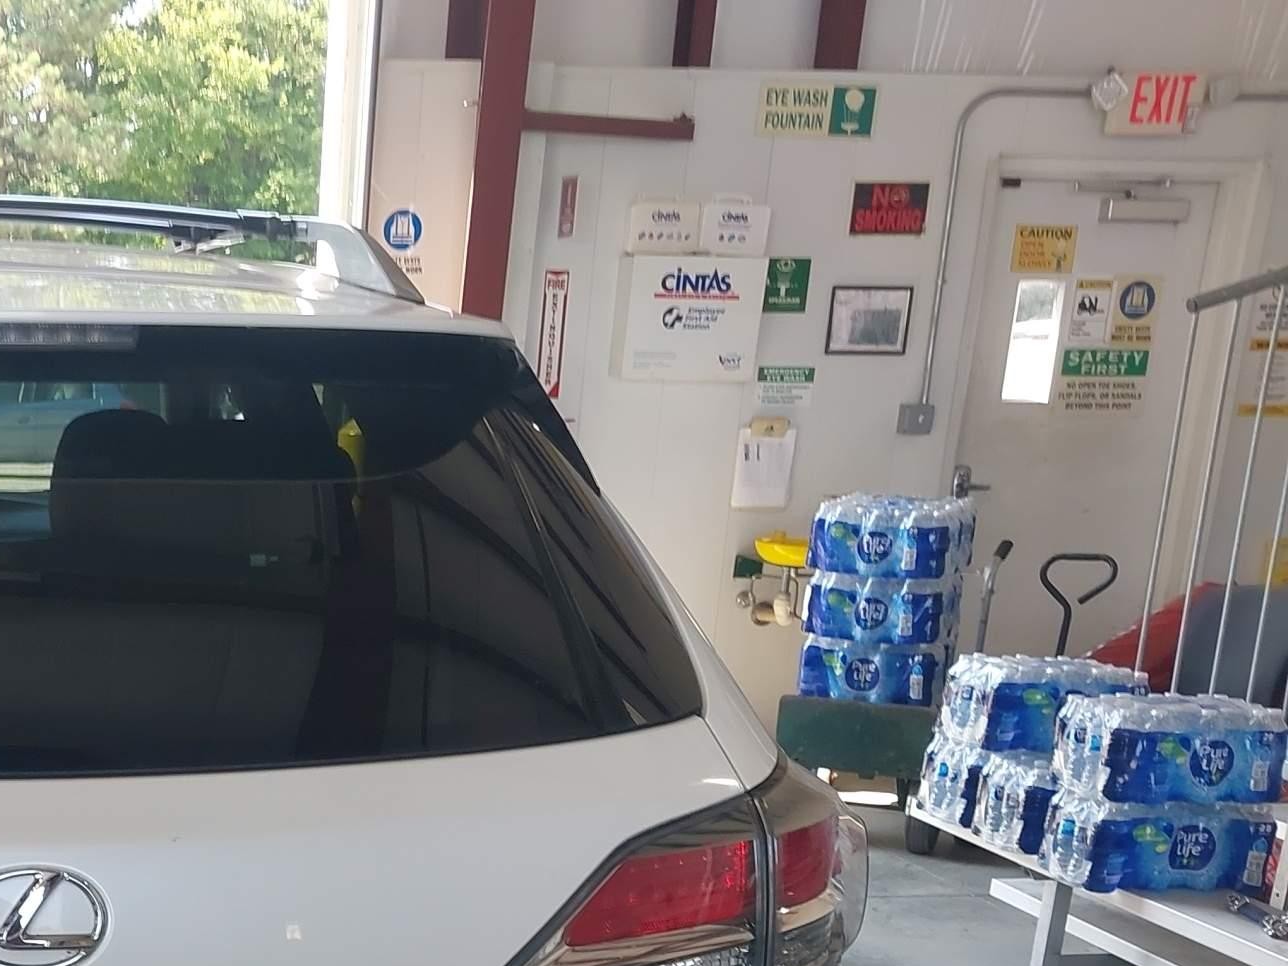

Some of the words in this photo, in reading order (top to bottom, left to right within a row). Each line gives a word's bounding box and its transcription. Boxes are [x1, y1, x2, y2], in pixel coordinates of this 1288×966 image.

[766, 87, 790, 107] EYE
[792, 87, 829, 107] WASH
[1129, 73, 1197, 124] EXIT
[763, 111, 824, 130] FOUNTAIN
[855, 208, 921, 232] SMOKING
[1019, 228, 1073, 240] CAUTION
[546, 279, 566, 291] FIRE
[1067, 351, 1144, 366] SAFETY
[1080, 363, 1129, 376] FIRST
[1078, 382, 1096, 390] OPEN
[1058, 392, 1073, 400] FLIP
[1099, 392, 1110, 400] OR
[1112, 402, 1132, 410] POINT
[1199, 745, 1229, 759] Pure
[1176, 831, 1209, 843] Pure
[1177, 843, 1202, 858] Life
